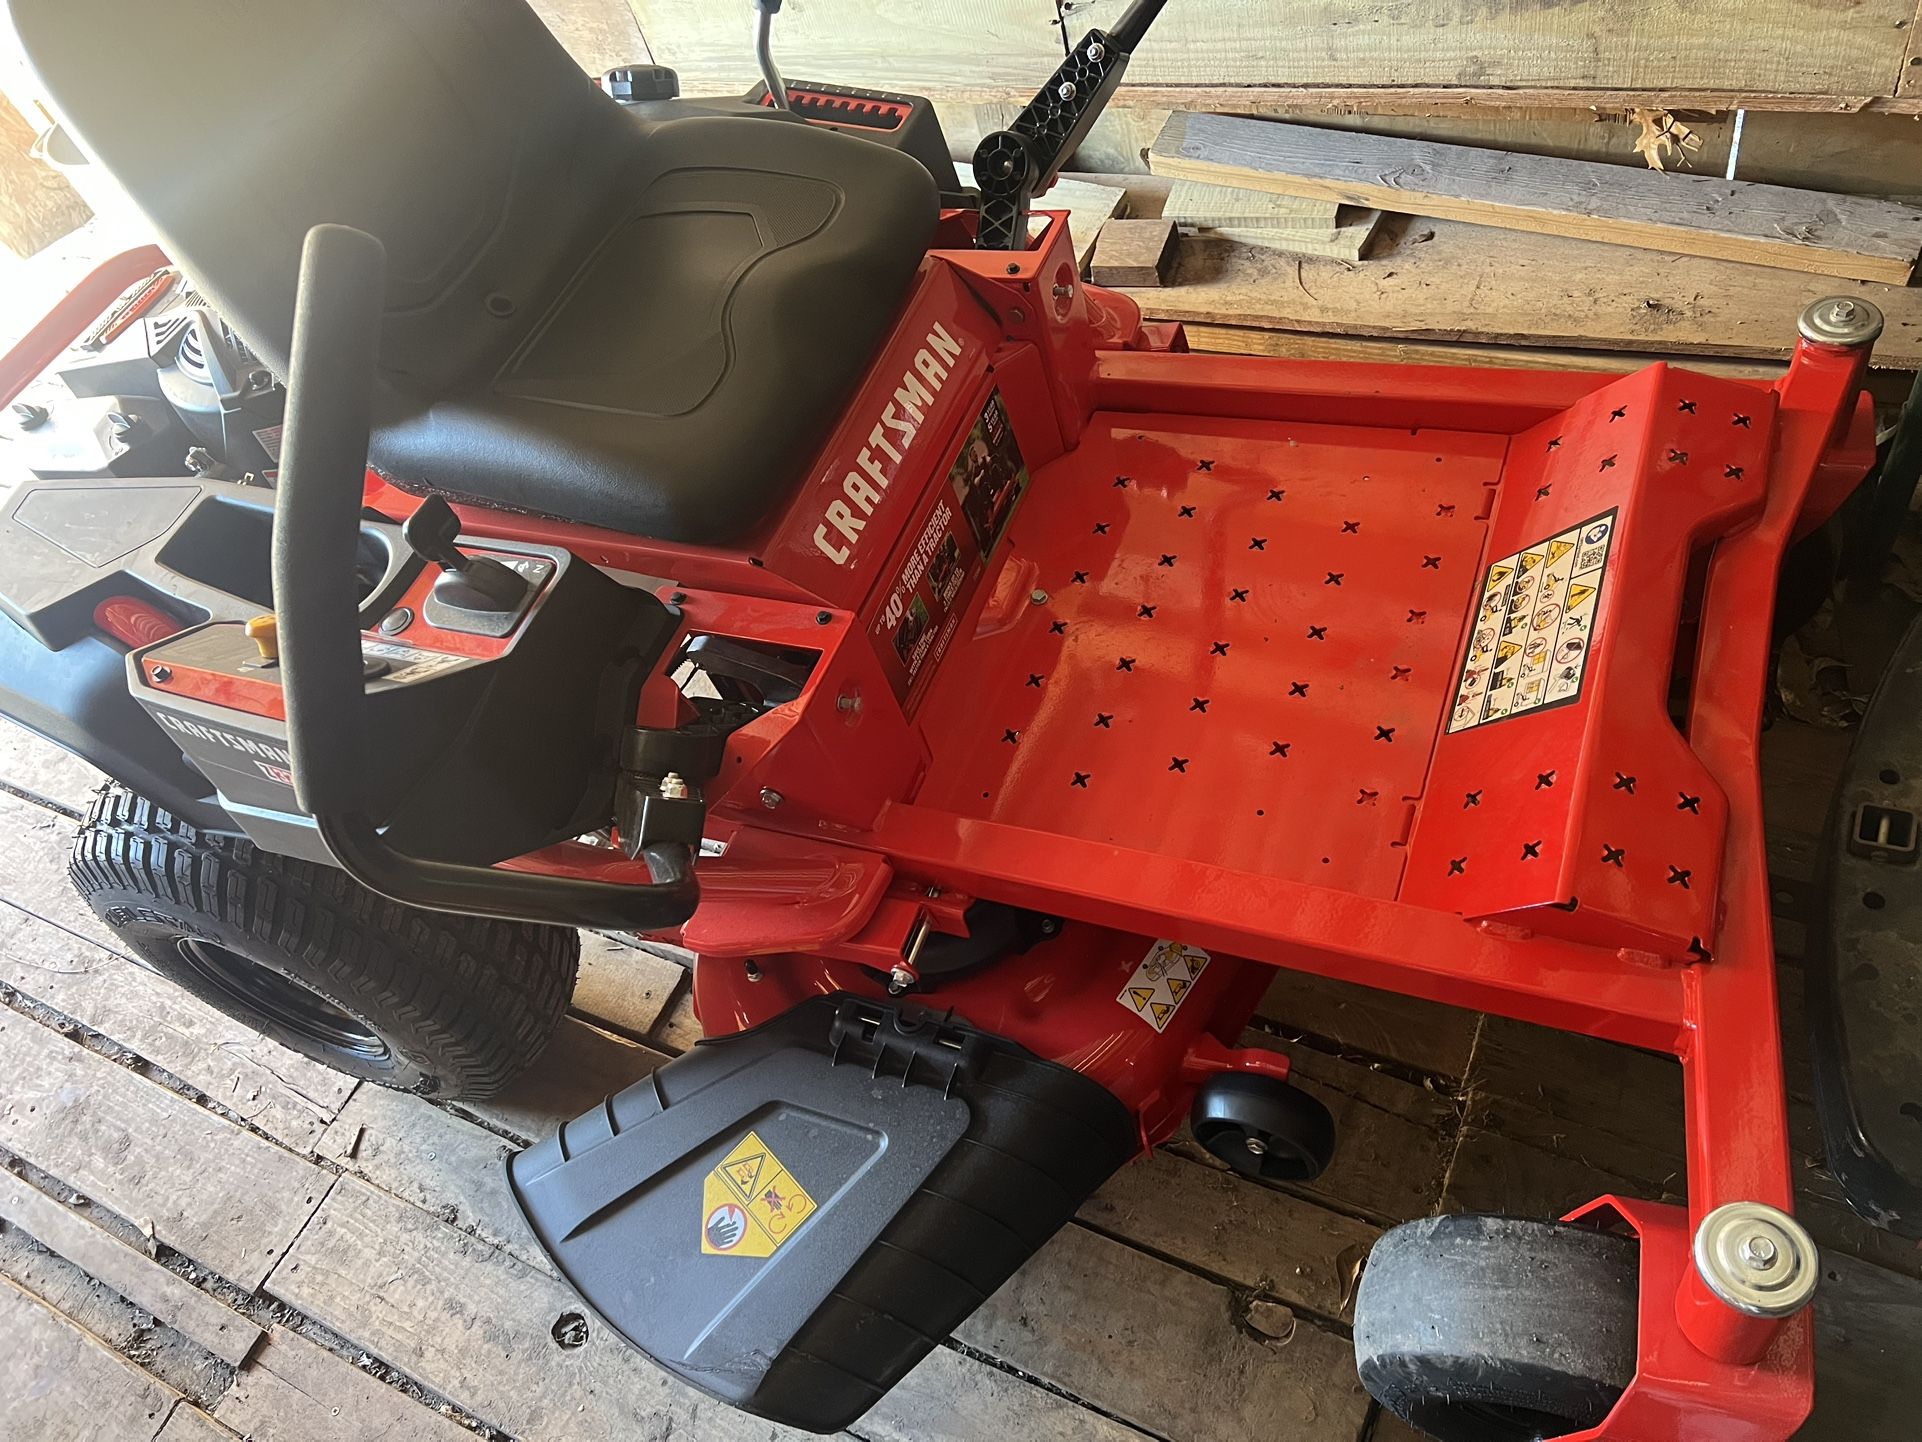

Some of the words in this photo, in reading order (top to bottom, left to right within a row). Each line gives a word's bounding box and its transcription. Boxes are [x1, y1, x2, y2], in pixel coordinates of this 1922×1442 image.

[813, 321, 962, 565] CRAFTSMAN
[901, 549, 921, 585] MORE
[917, 499, 945, 554] EFFICIENT
[906, 561, 925, 594] THAN
[926, 507, 952, 556] TRACTOR
